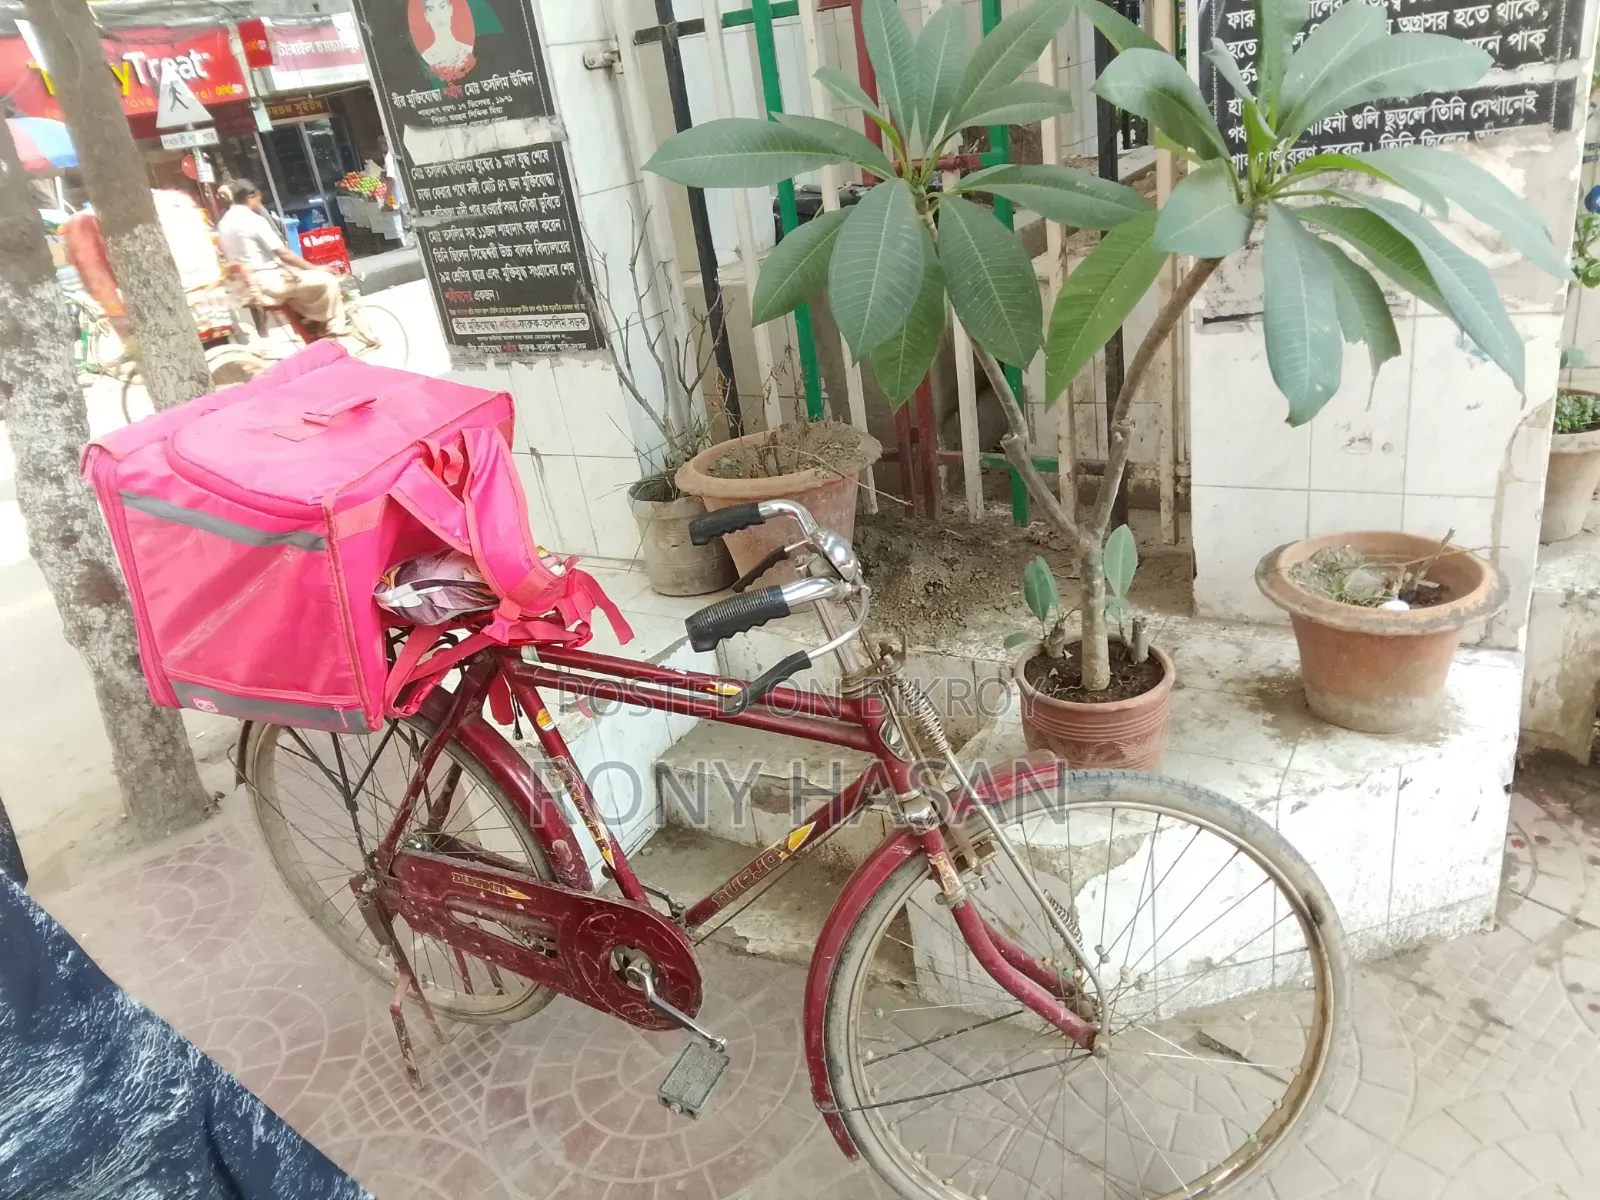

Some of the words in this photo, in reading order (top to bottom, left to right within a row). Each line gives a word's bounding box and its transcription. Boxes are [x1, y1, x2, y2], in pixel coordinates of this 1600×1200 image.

[1397, 11, 1449, 33] অগ্রসর
[1453, 4, 1492, 28] হতে
[122, 48, 209, 87] Treat
[480, 74, 509, 91] তসলিম
[1351, 106, 1380, 131] গুলি
[1432, 95, 1467, 122] তিনি
[1471, 88, 1539, 119] সেখানেই
